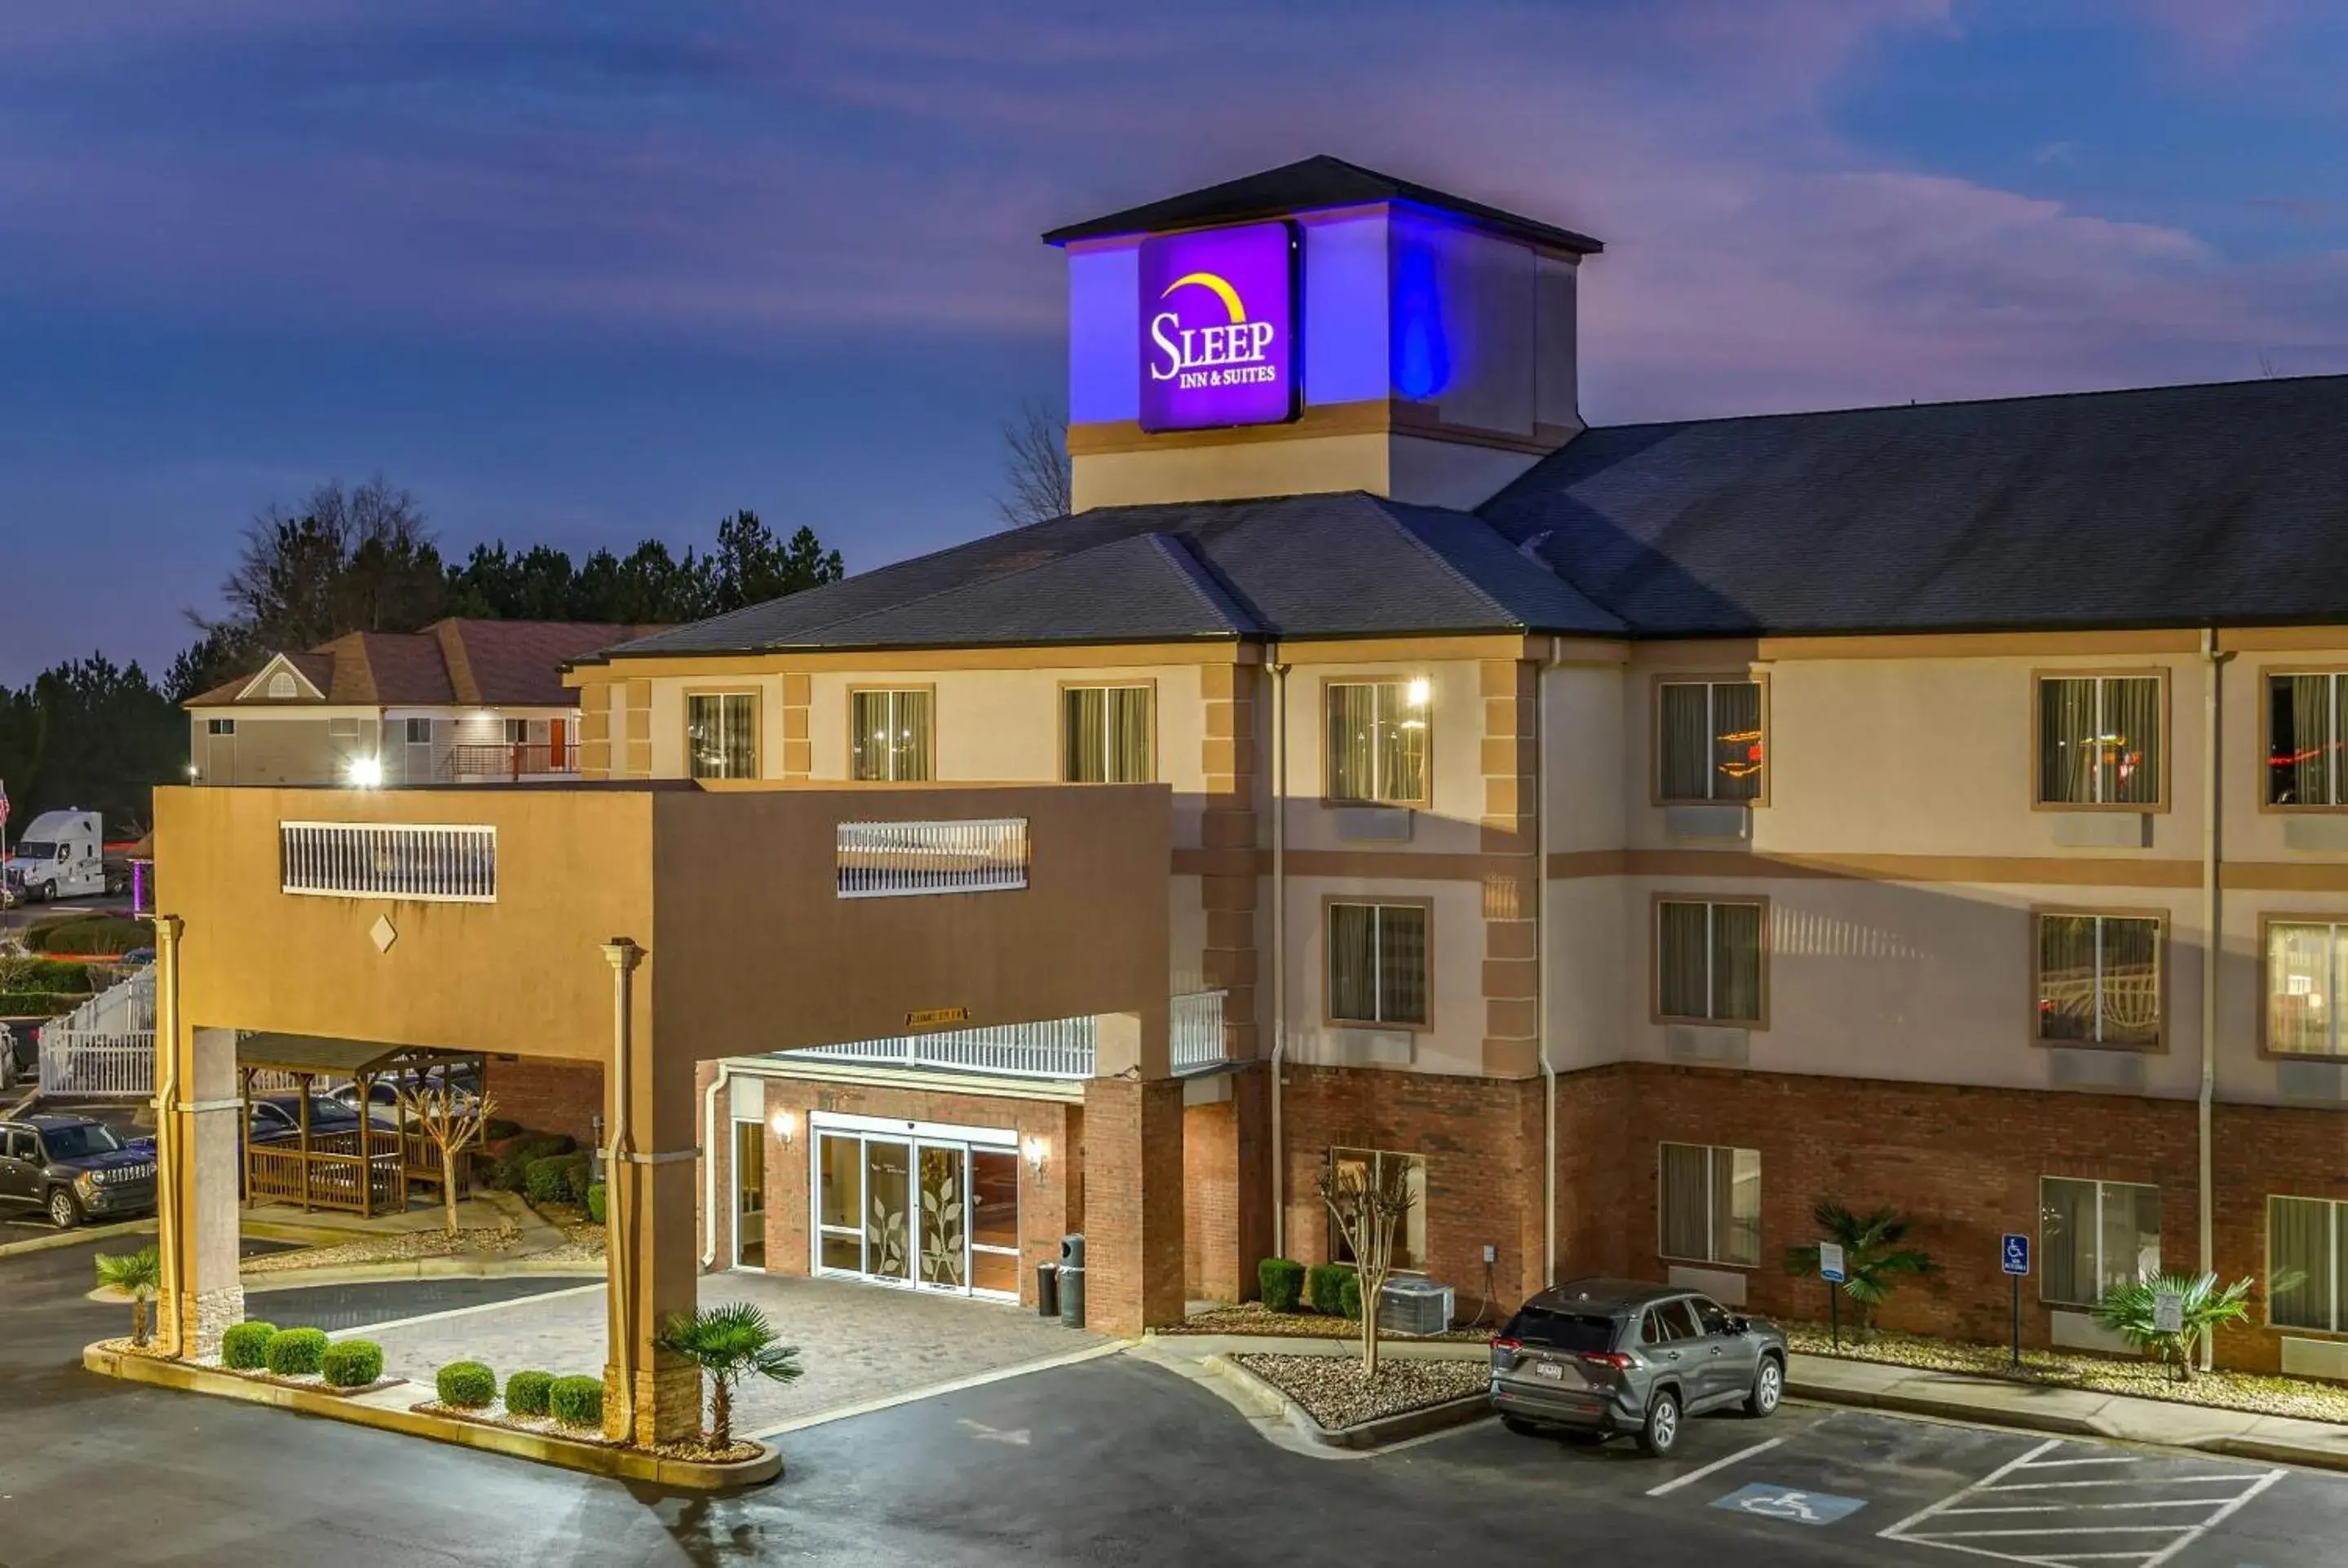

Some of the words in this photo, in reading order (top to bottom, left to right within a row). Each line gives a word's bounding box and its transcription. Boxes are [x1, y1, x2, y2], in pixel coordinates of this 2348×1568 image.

[1151, 312, 1275, 380] SLEEP
[1179, 372, 1208, 389] INN
[1210, 370, 1222, 386] &
[1223, 365, 1276, 385] SUITES
